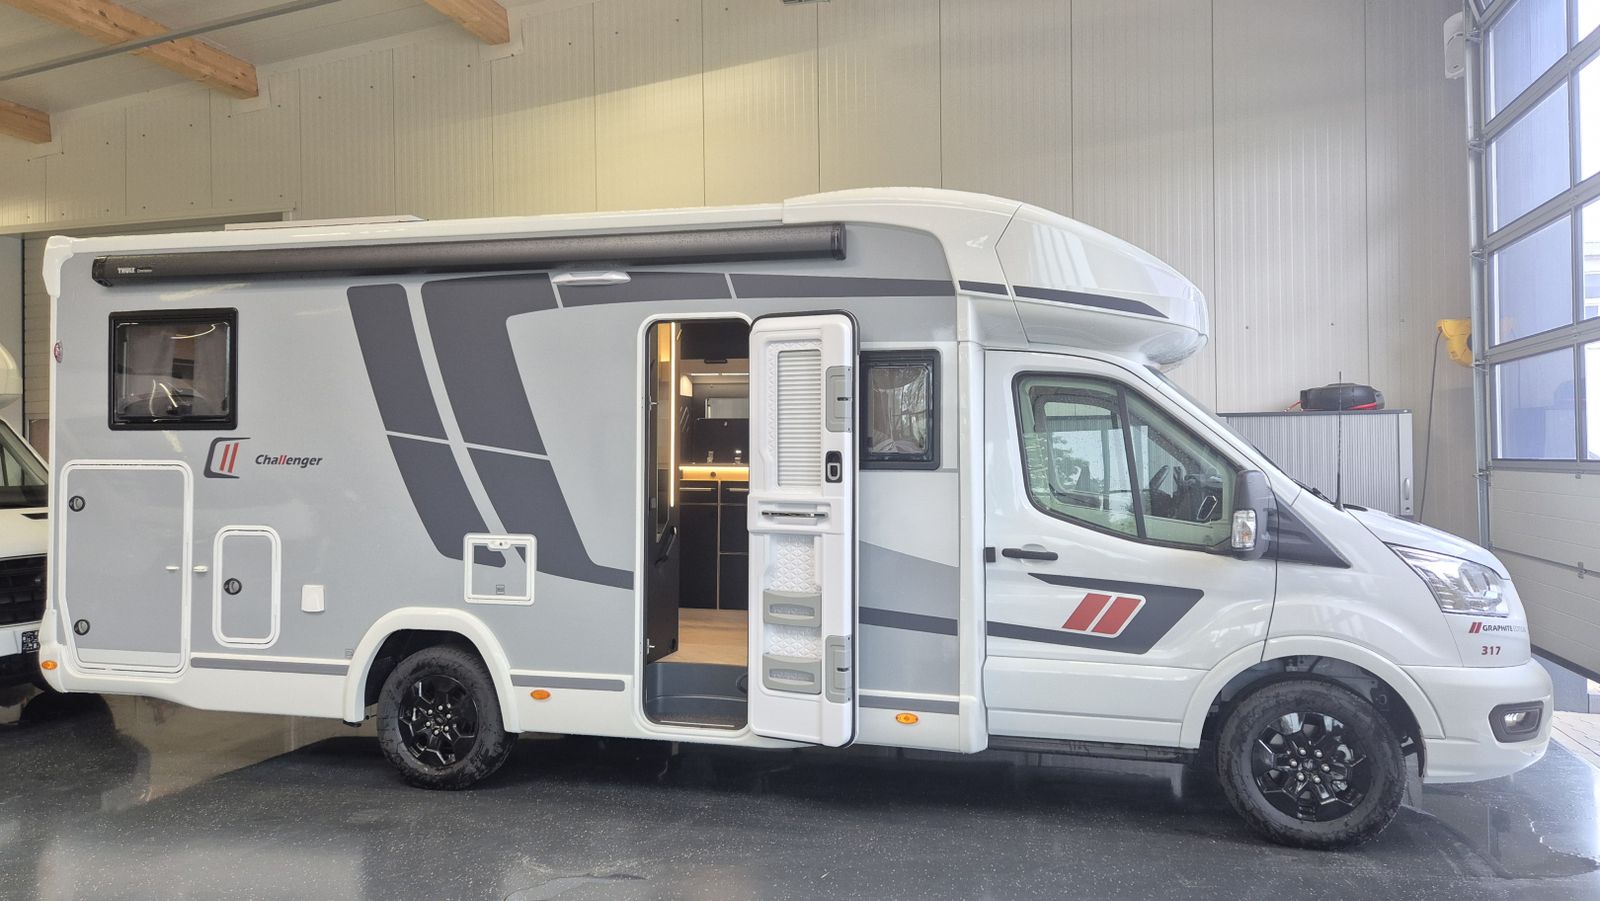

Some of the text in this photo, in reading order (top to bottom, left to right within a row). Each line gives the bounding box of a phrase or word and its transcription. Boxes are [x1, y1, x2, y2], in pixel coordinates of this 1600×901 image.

[255, 454, 323, 468] Challenger
[1482, 624, 1513, 632] GRAPHITE
[1481, 645, 1501, 656] 317
